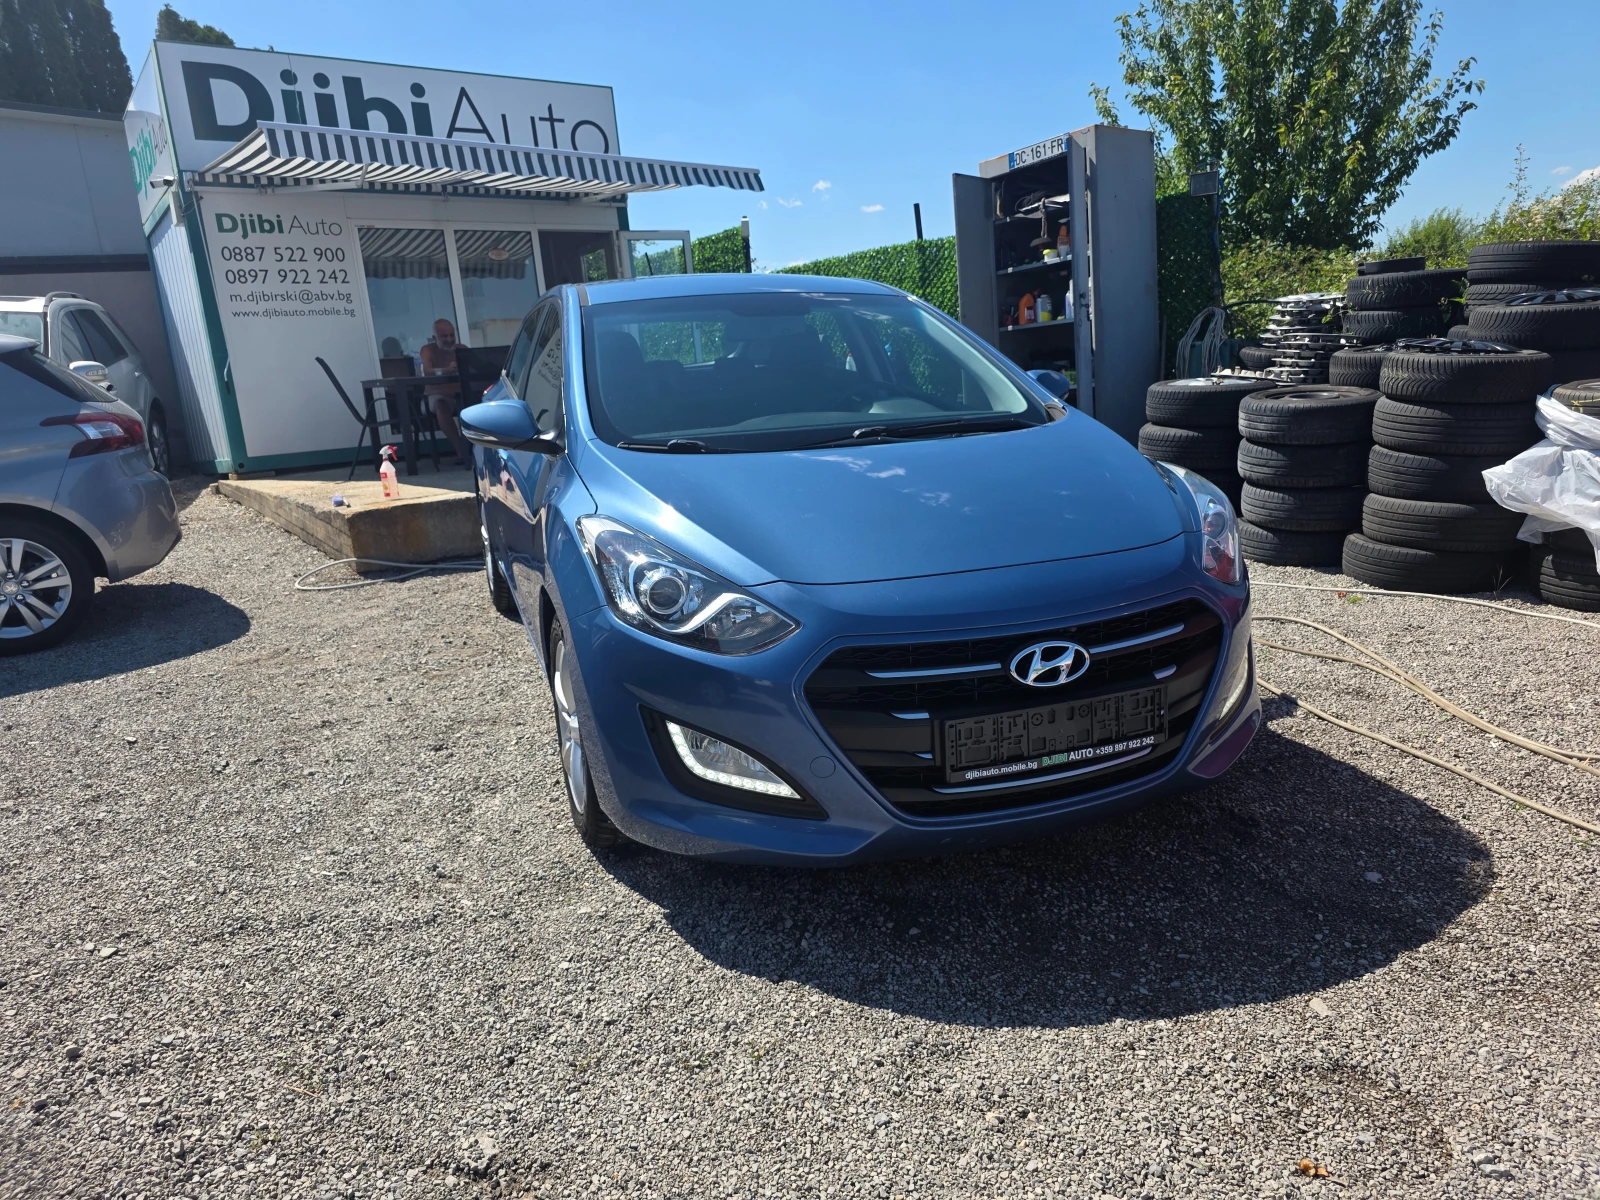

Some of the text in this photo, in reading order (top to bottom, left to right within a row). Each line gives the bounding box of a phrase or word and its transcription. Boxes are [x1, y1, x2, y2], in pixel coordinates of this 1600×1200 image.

[181, 61, 610, 154] Djibi Auto
[1015, 138, 1064, 166] DC-161-FR
[215, 213, 343, 240] Djibi Auto
[221, 246, 346, 263] 0887 522 900
[225, 269, 350, 285] 0897 922 242
[229, 289, 353, 305] m.djibirski@abv.bg
[231, 307, 356, 320] www.djibiauto.mobile.bg
[965, 736, 1155, 780] djibiauto.mobile.bg DJIBI AUTO +359 897 922 242
